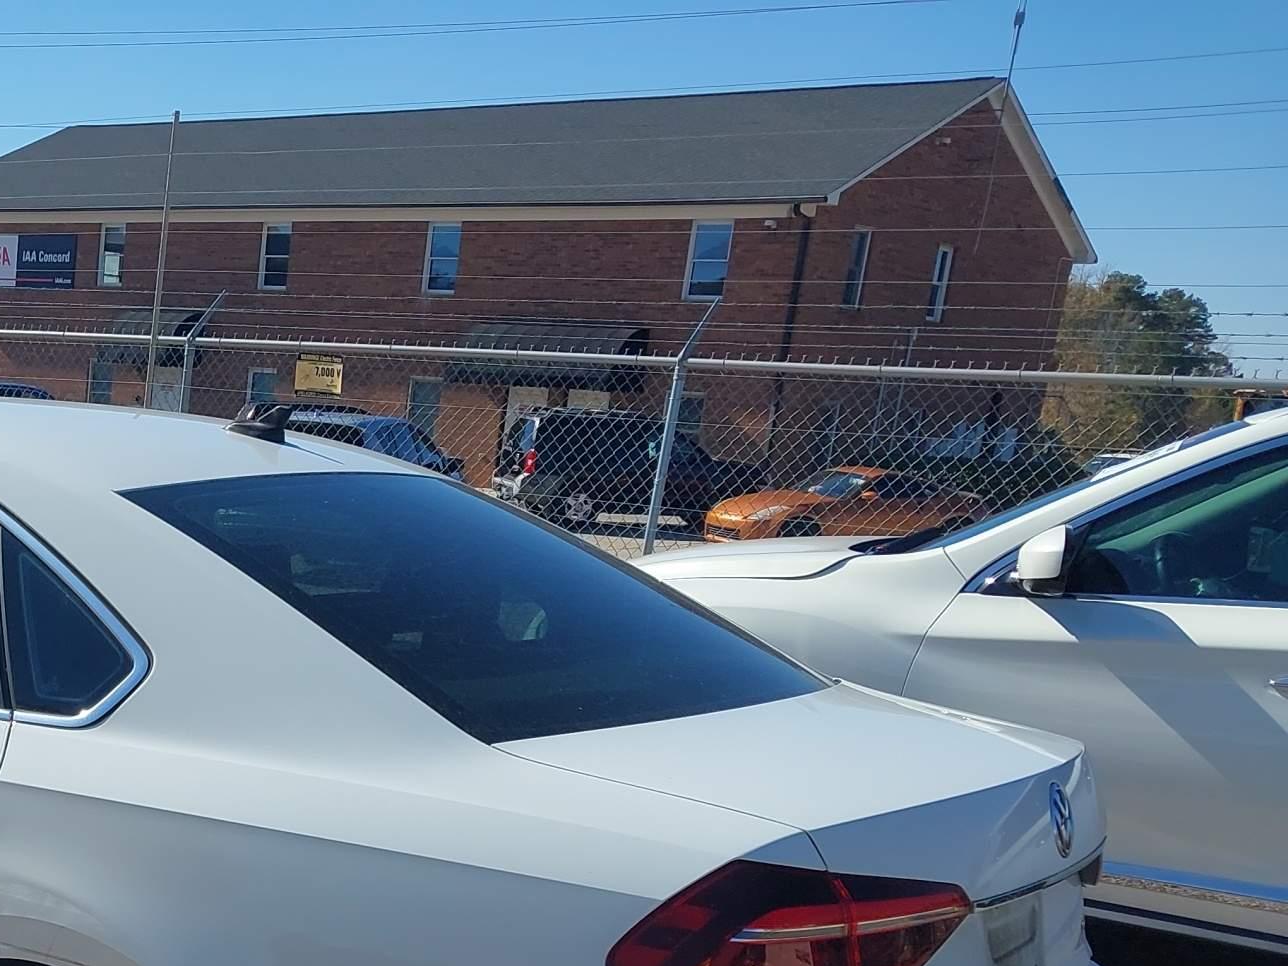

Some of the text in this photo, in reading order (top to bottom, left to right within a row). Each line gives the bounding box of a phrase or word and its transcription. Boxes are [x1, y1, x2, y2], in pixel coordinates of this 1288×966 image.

[22, 249, 71, 263] IAA Concord
[314, 366, 342, 379] 7,000 V
